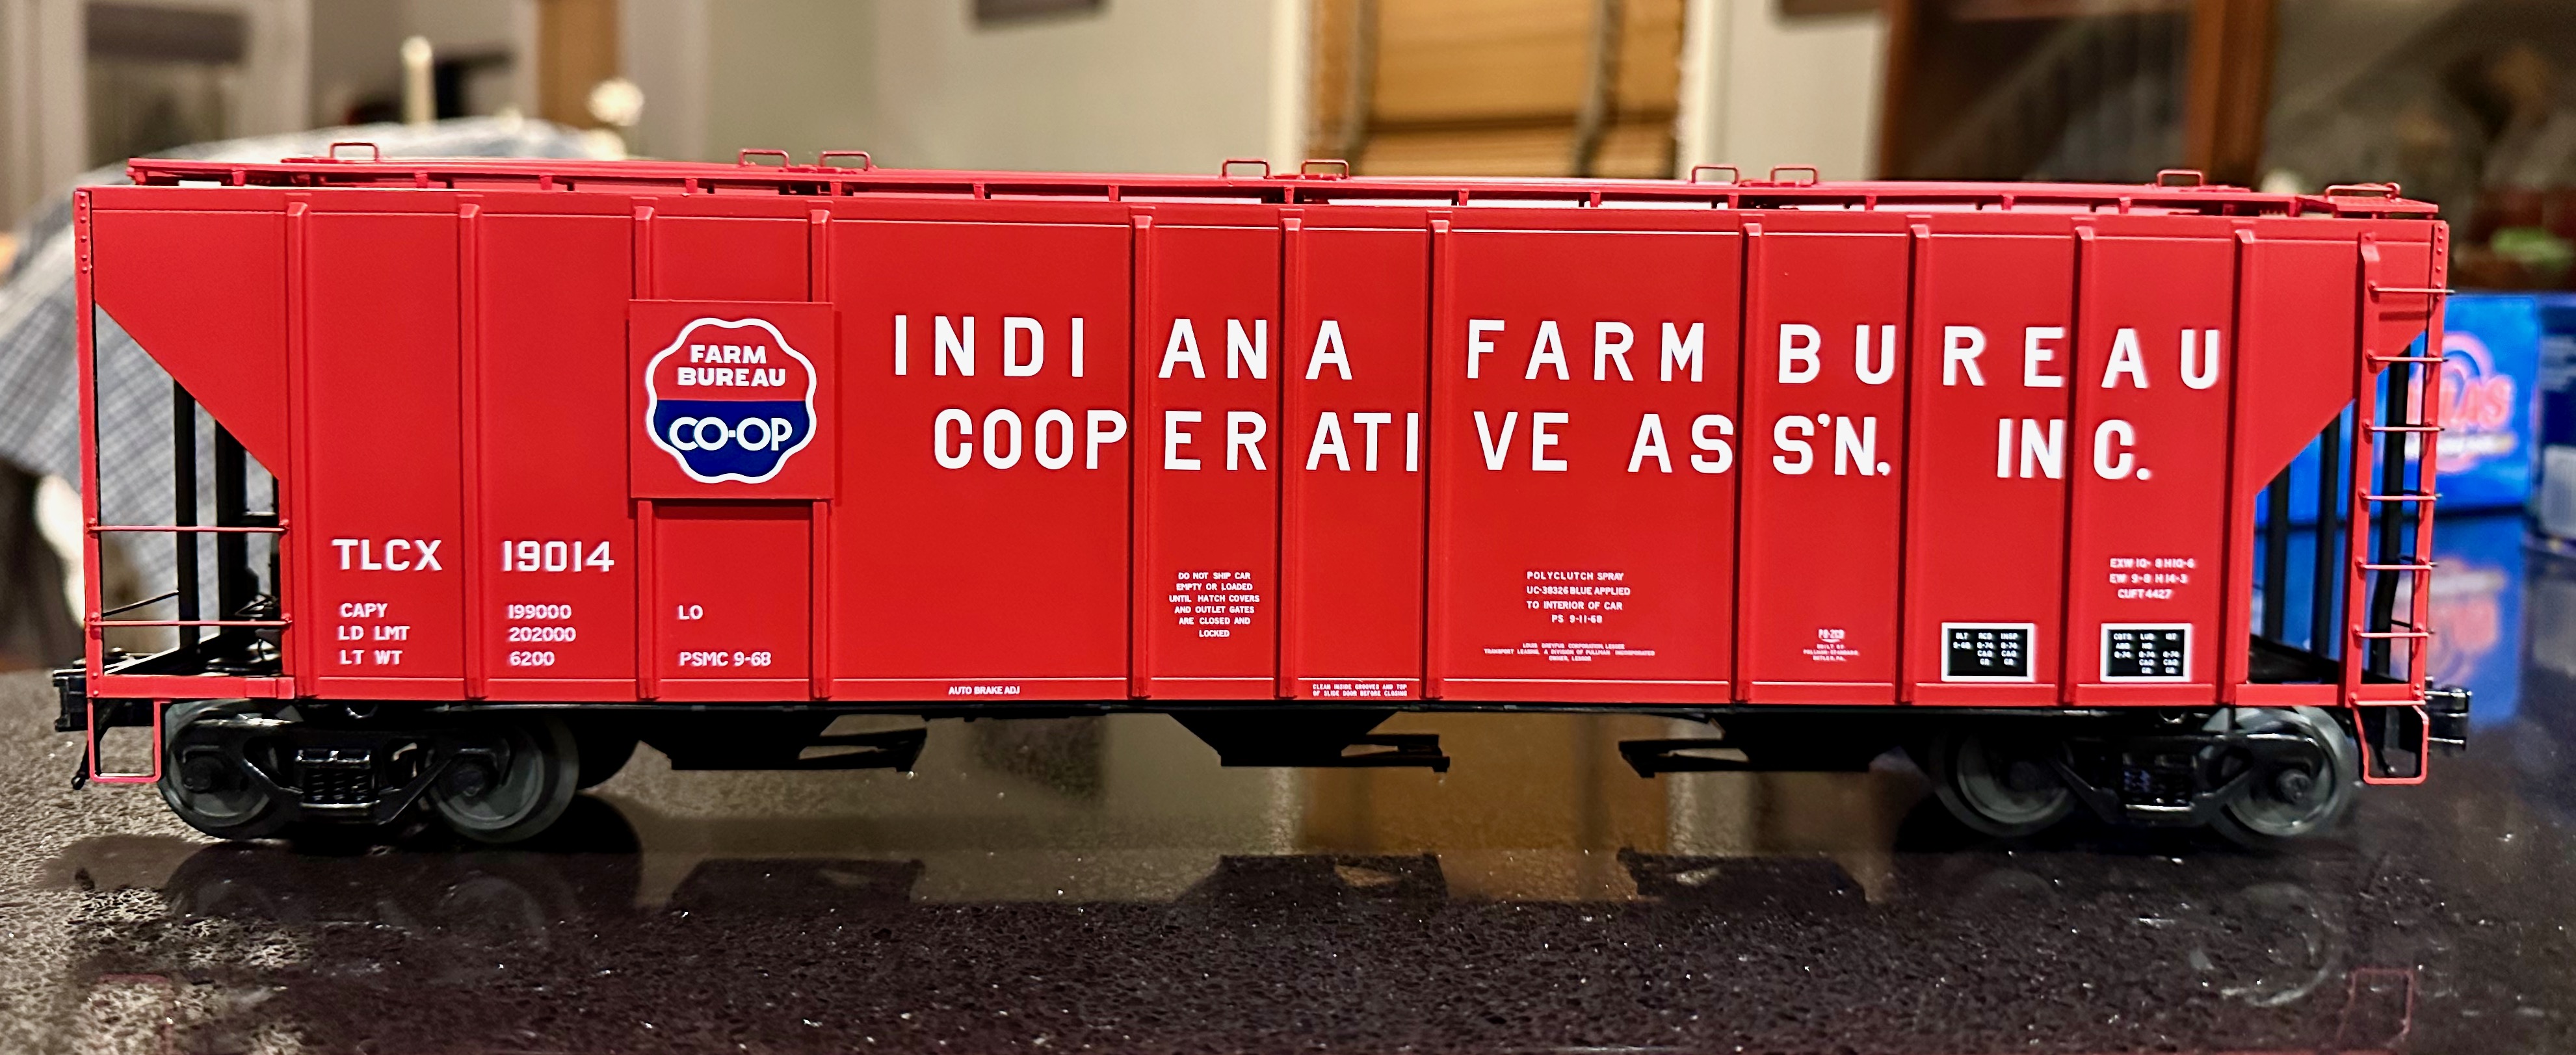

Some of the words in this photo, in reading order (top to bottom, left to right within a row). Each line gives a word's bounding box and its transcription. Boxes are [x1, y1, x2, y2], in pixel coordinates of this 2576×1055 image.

[690, 345, 767, 364] FARM
[895, 315, 1352, 380] INDIANA
[1467, 319, 1704, 382] FARM
[1778, 324, 2220, 389] BUREAU
[677, 367, 786, 387] BUREAU
[669, 416, 793, 451] CO-OP
[934, 408, 1569, 472] COOPERATIVE
[1997, 418, 2152, 480] INC.
[332, 538, 443, 571] TLCX
[503, 540, 615, 572] 19014
[1213, 571, 1231, 580] SHIP
[1234, 571, 1251, 580] CAR
[1527, 571, 1594, 580] POLYCLUTCH
[1597, 572, 1624, 581] SPRAY
[1176, 582, 1202, 591] EMPTY
[1205, 582, 1218, 591] OR
[1221, 582, 1253, 592] LOADED
[1526, 586, 1569, 595] UC-38326
[1570, 586, 1593, 595] BLUE
[1594, 586, 1631, 596] APPLIED
[1168, 594, 1192, 603] UNTIL
[1197, 594, 1226, 603] HATCH
[1228, 594, 1260, 603] COVERS
[340, 603, 388, 618] CAPY
[508, 604, 572, 619] 199000
[1194, 605, 1226, 614] OUTLET
[1229, 605, 1255, 614] GATES
[1526, 600, 1540, 609] TO
[1543, 601, 1584, 610] INTERIOR
[1587, 601, 1601, 610] OF
[1603, 601, 1623, 610] CAR
[678, 605, 703, 620] LO
[1551, 614, 1564, 623] PS
[1178, 617, 1194, 625] ARE
[1199, 616, 1231, 625] CLOSED
[1233, 616, 1251, 625] AND
[338, 625, 364, 641] LD
[374, 625, 411, 641] LMT
[508, 627, 577, 642] 202000
[1198, 629, 1230, 638] LOCKED
[340, 649, 365, 665] LT
[374, 649, 403, 665] WT
[509, 651, 555, 666] 6200
[679, 651, 729, 667] PSMC
[733, 651, 772, 667] 9-68
[948, 686, 973, 695] AUTO
[973, 686, 1003, 695] BRAKE
[1003, 685, 1020, 695] ADJ
